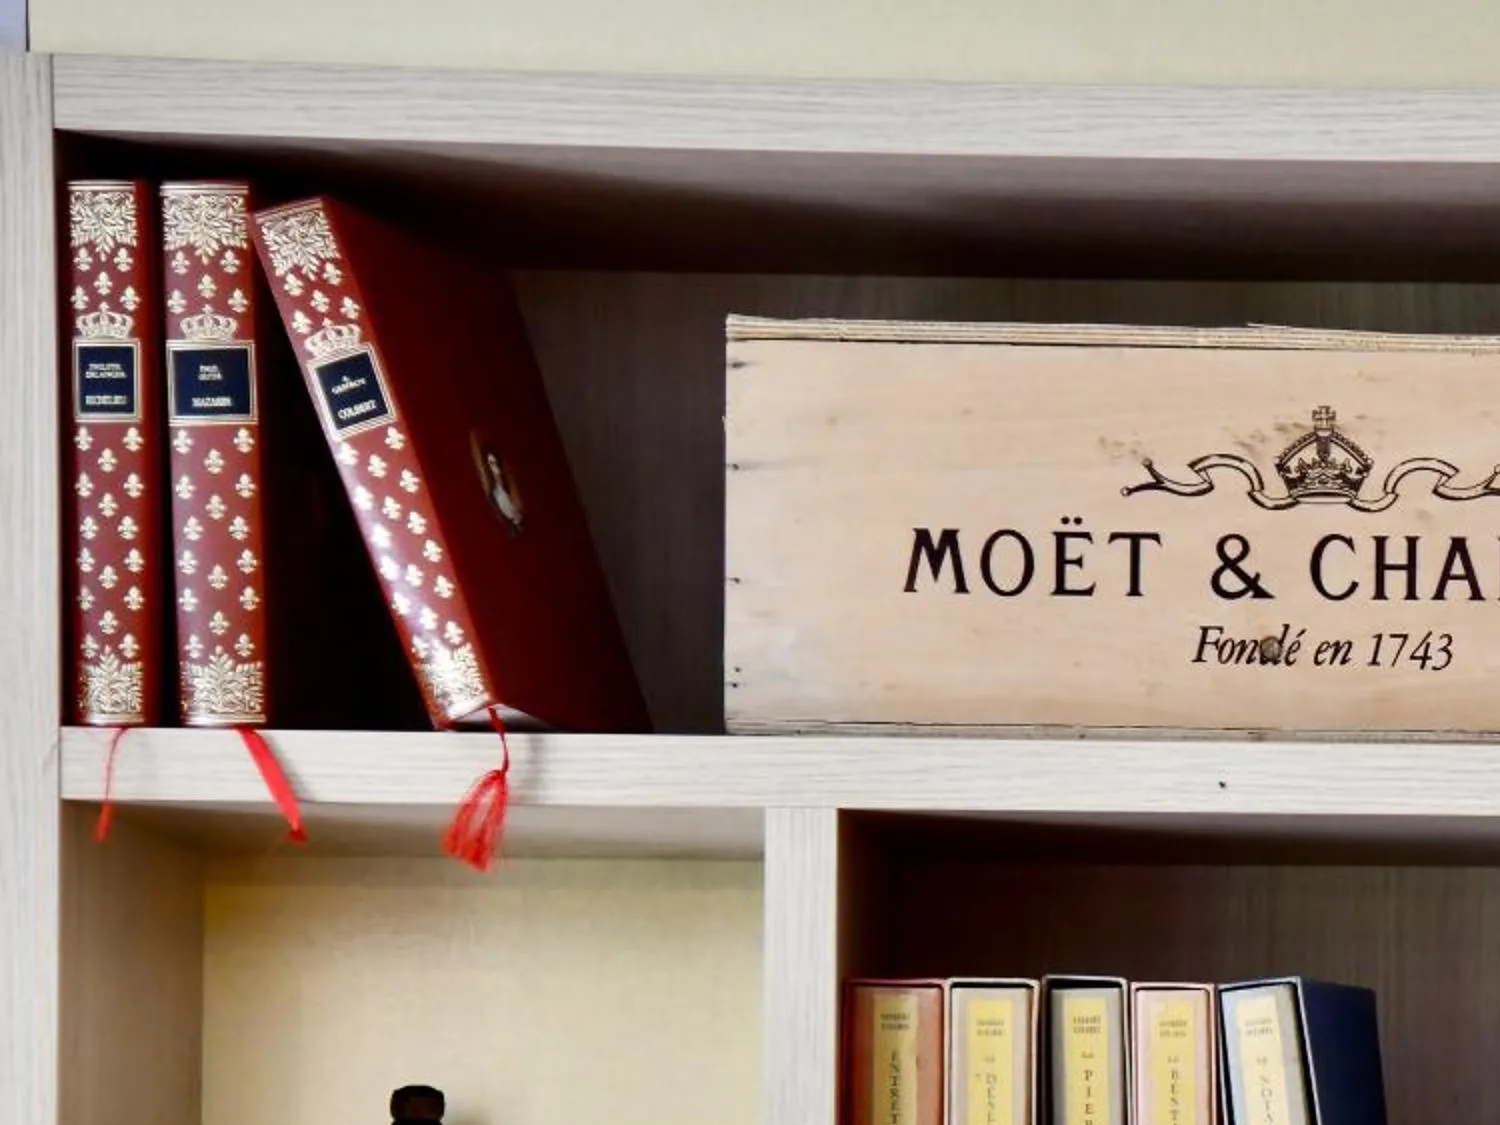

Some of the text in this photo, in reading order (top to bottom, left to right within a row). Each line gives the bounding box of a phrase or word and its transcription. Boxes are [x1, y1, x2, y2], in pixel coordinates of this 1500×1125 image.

[903, 515, 1162, 597] MOËT
[1210, 532, 1275, 600] &
[1191, 624, 1454, 671] Fondé en 1743
